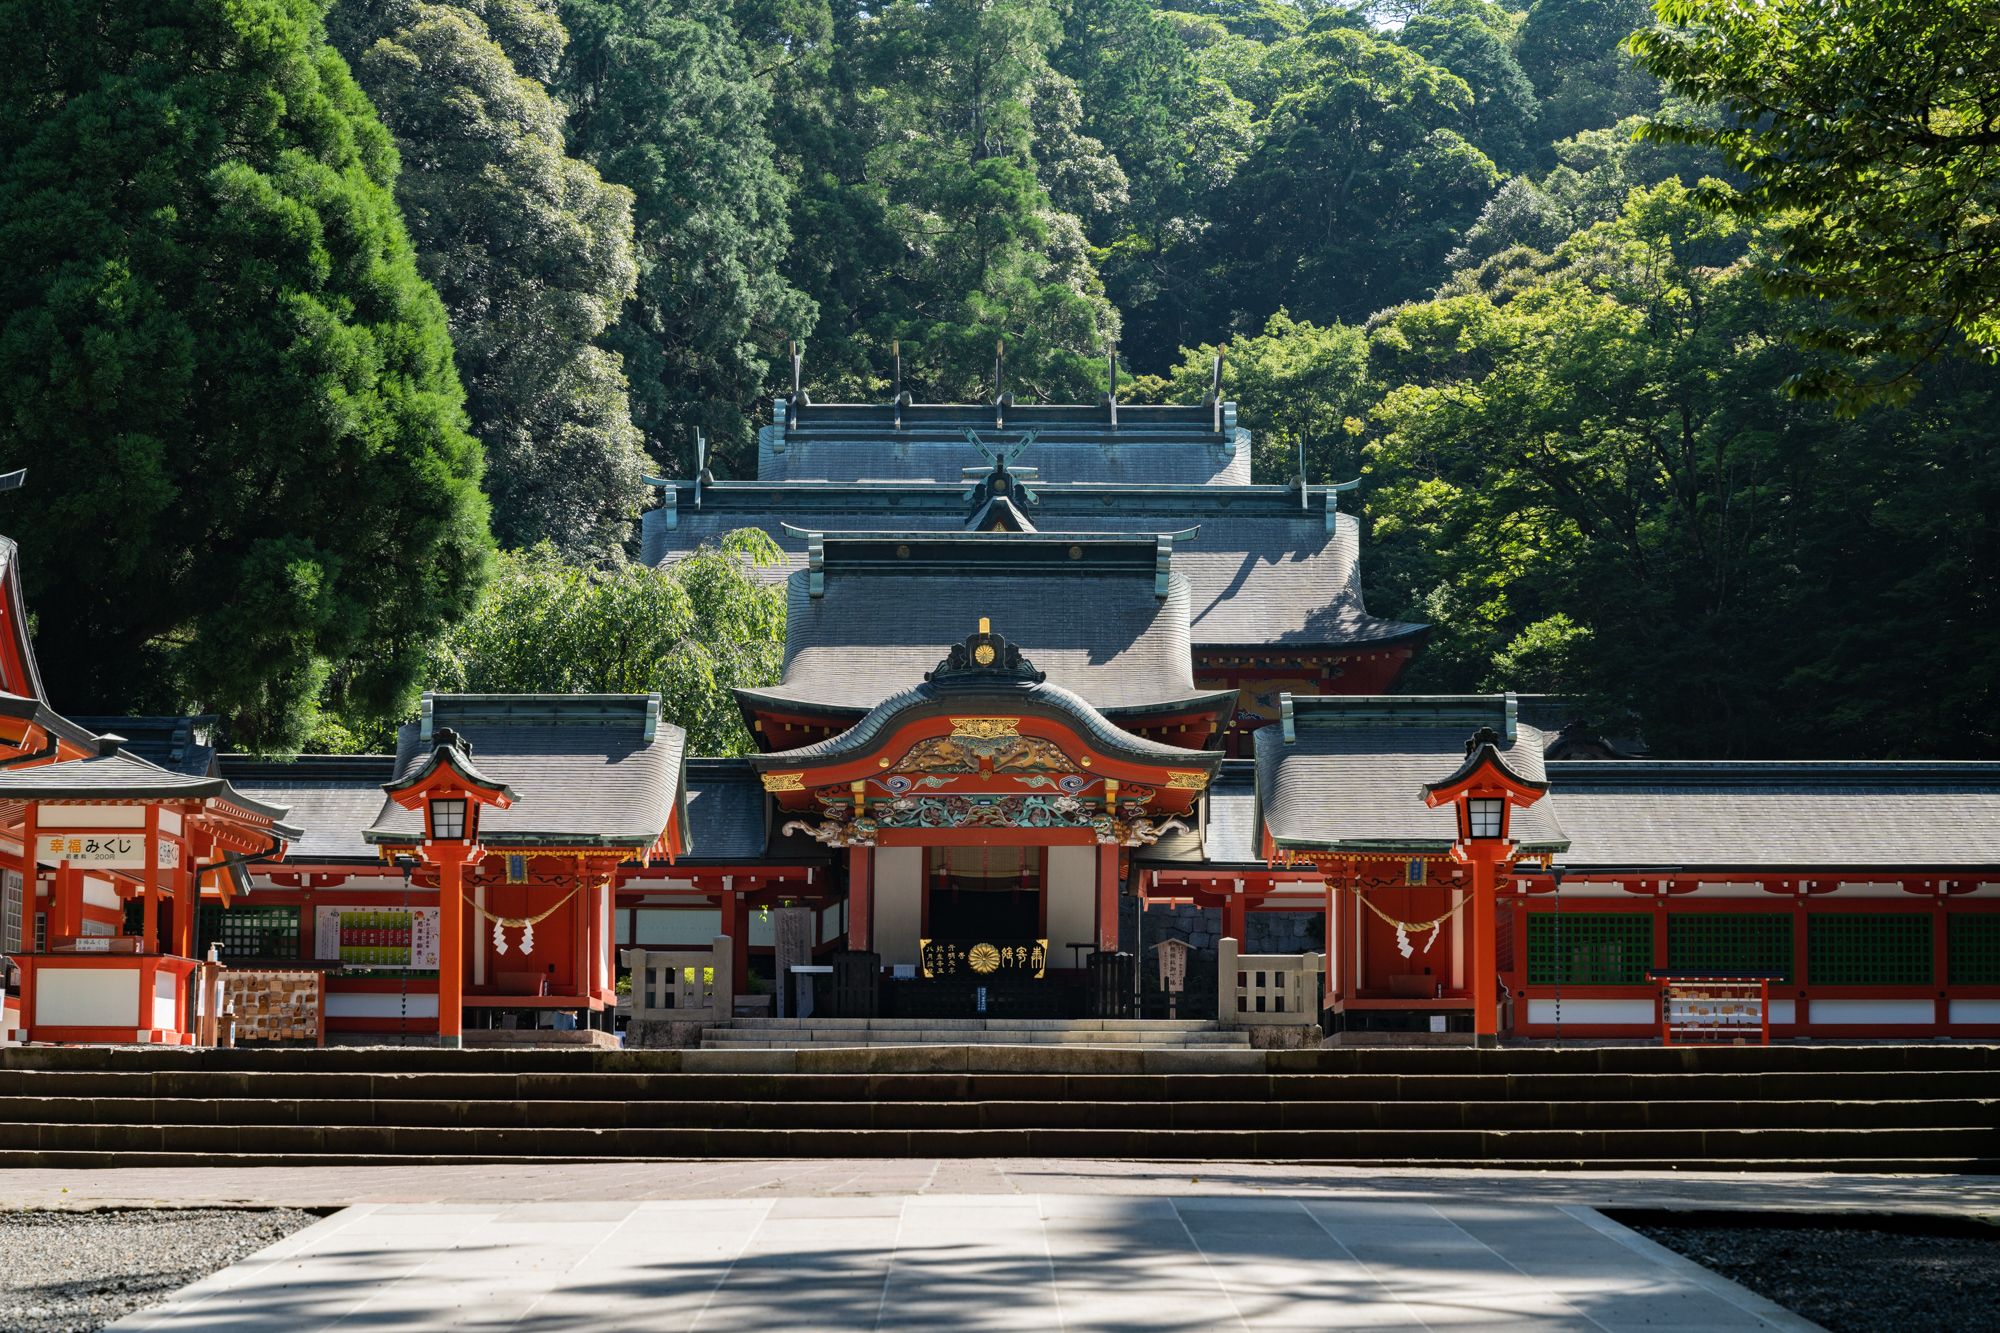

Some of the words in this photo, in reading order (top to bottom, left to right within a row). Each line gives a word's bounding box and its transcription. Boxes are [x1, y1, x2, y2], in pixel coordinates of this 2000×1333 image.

[50, 838, 131, 853] 幸福みくじ
